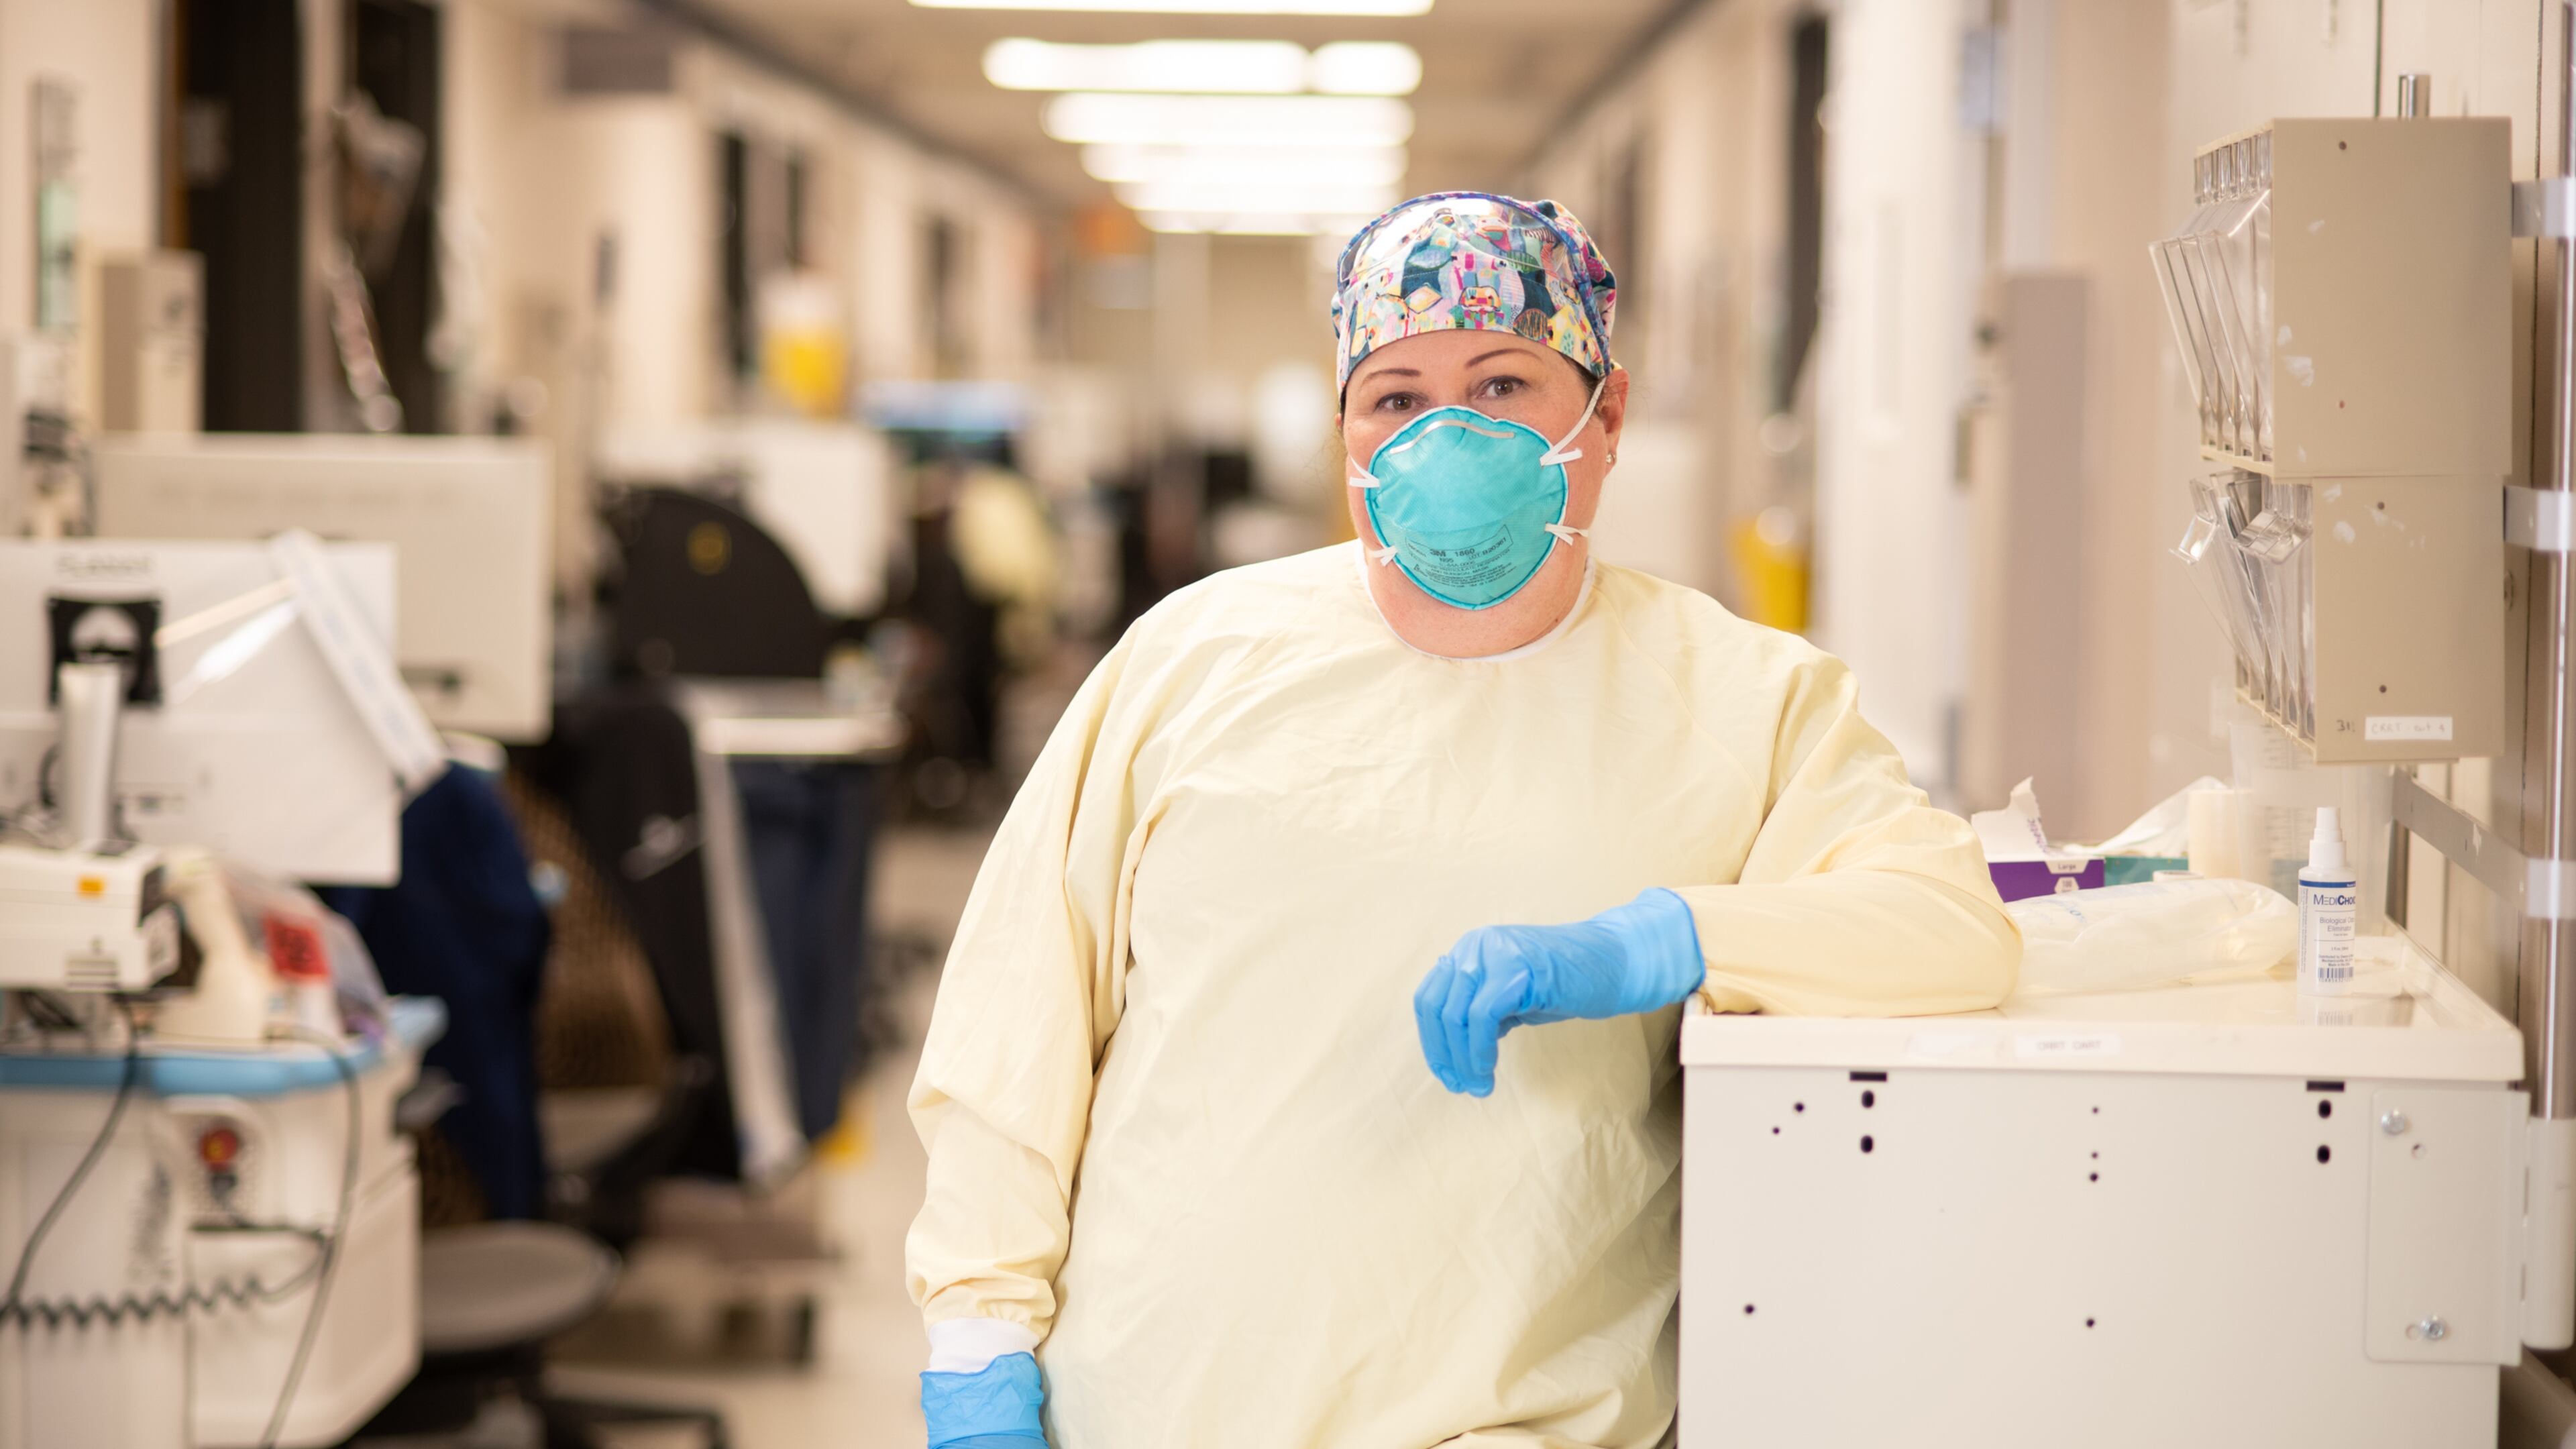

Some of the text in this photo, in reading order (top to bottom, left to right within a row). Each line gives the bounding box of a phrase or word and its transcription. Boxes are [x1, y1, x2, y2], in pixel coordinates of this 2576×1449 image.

[1430, 548, 1446, 557] 3M
[1454, 547, 1475, 557] 1860
[2058, 863, 2077, 871] Large
[2320, 917, 2347, 926] Biological
